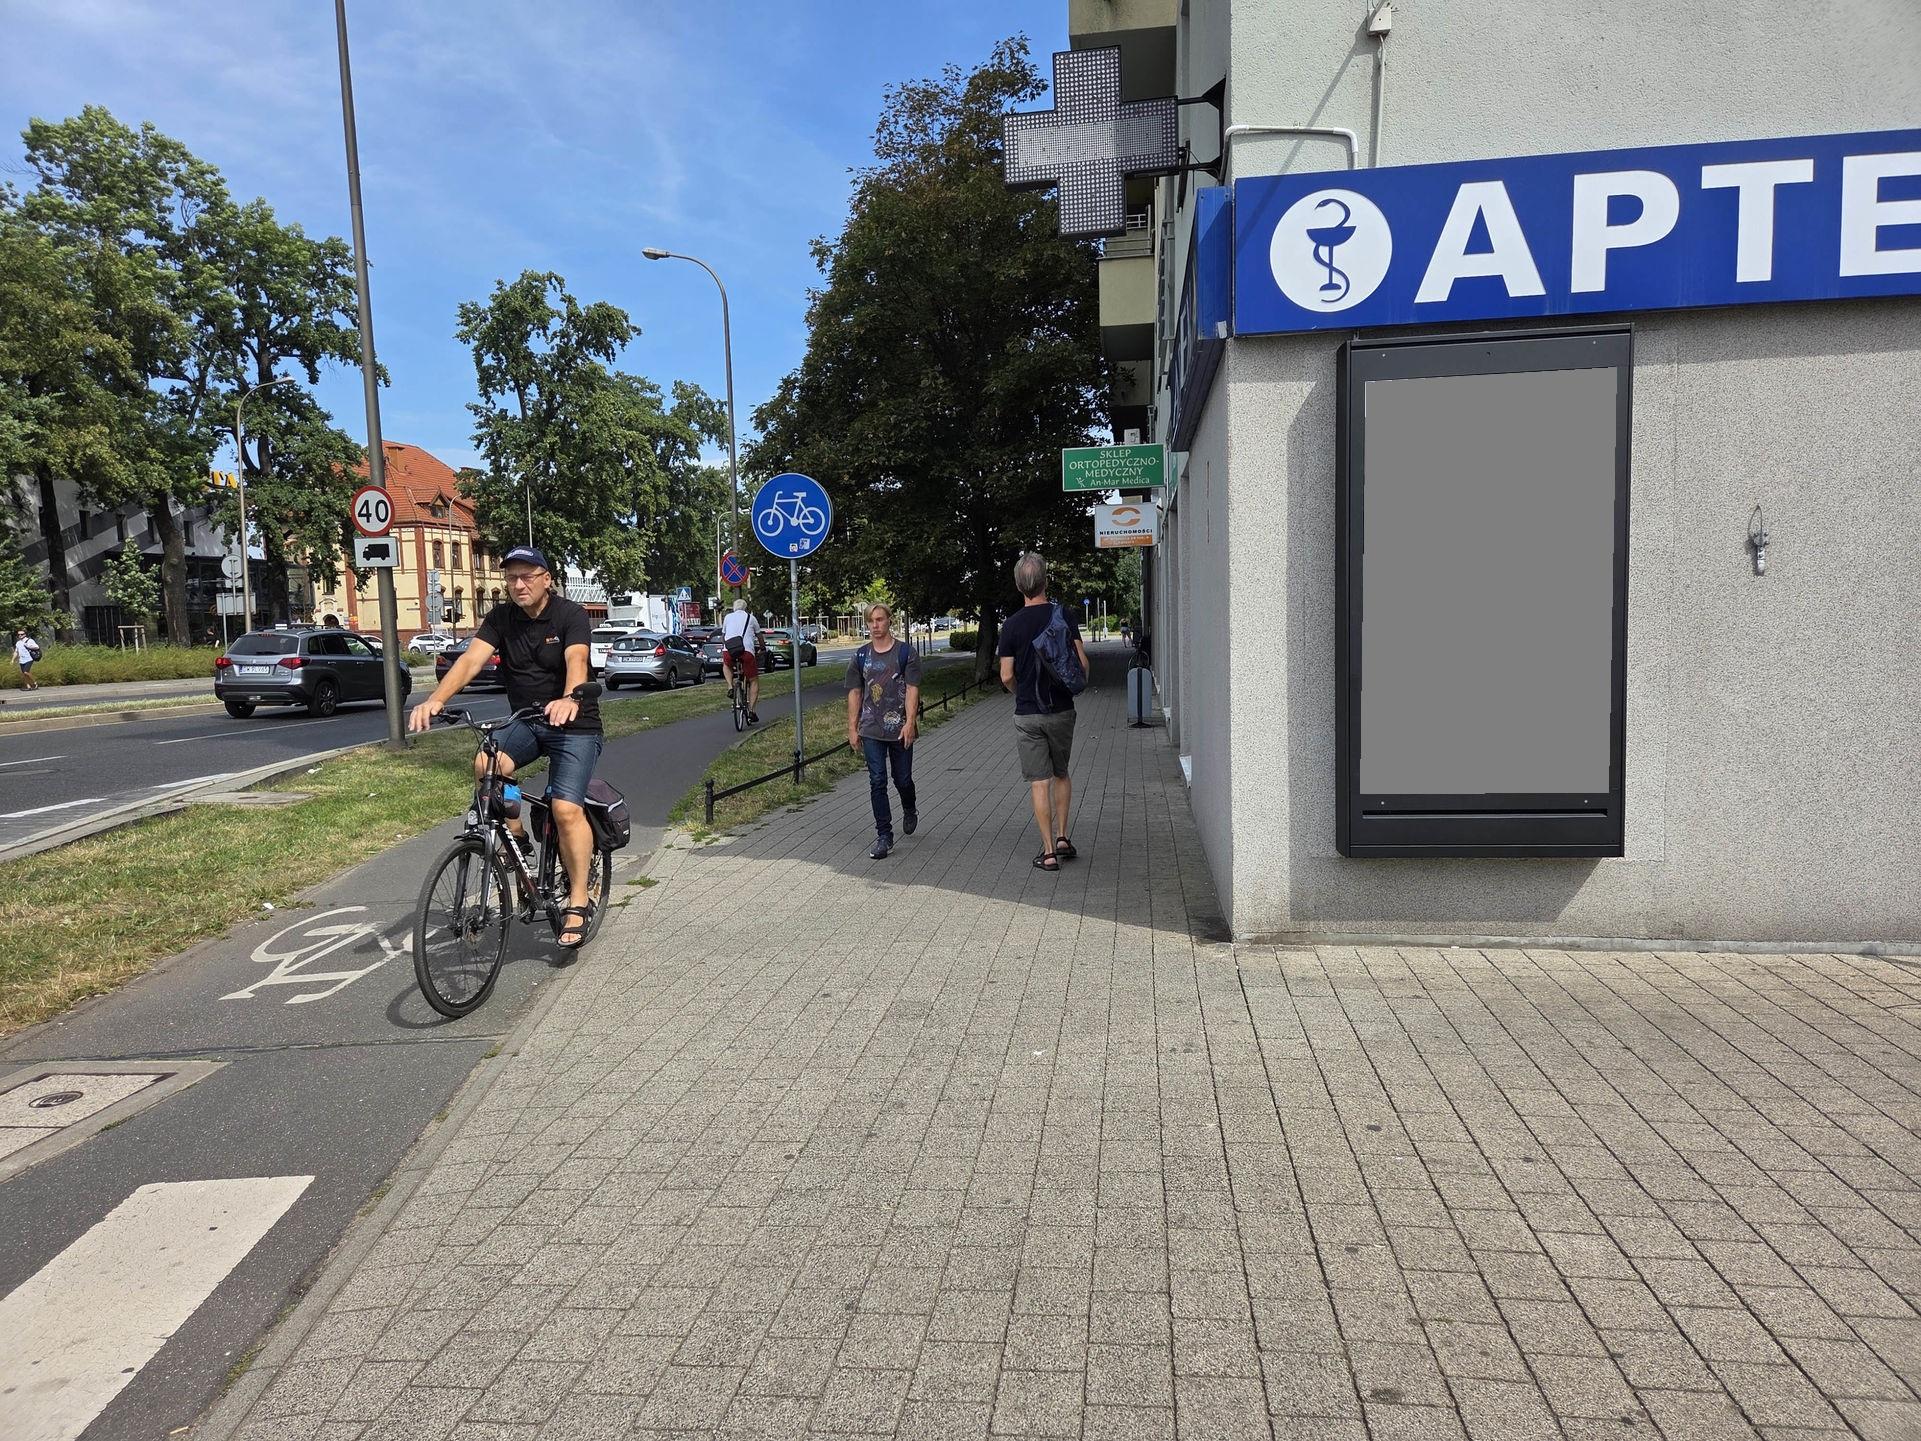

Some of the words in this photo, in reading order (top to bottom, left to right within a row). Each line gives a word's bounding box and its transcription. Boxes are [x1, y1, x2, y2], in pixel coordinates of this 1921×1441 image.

[1413, 151, 1921, 304] APTE
[1099, 449, 1132, 459] SKLEP
[1069, 457, 1160, 470] ORTOPEDYCZNO-
[1085, 467, 1144, 477] MEDYCZNY
[1122, 476, 1150, 485] Medica
[357, 499, 389, 523] 40
